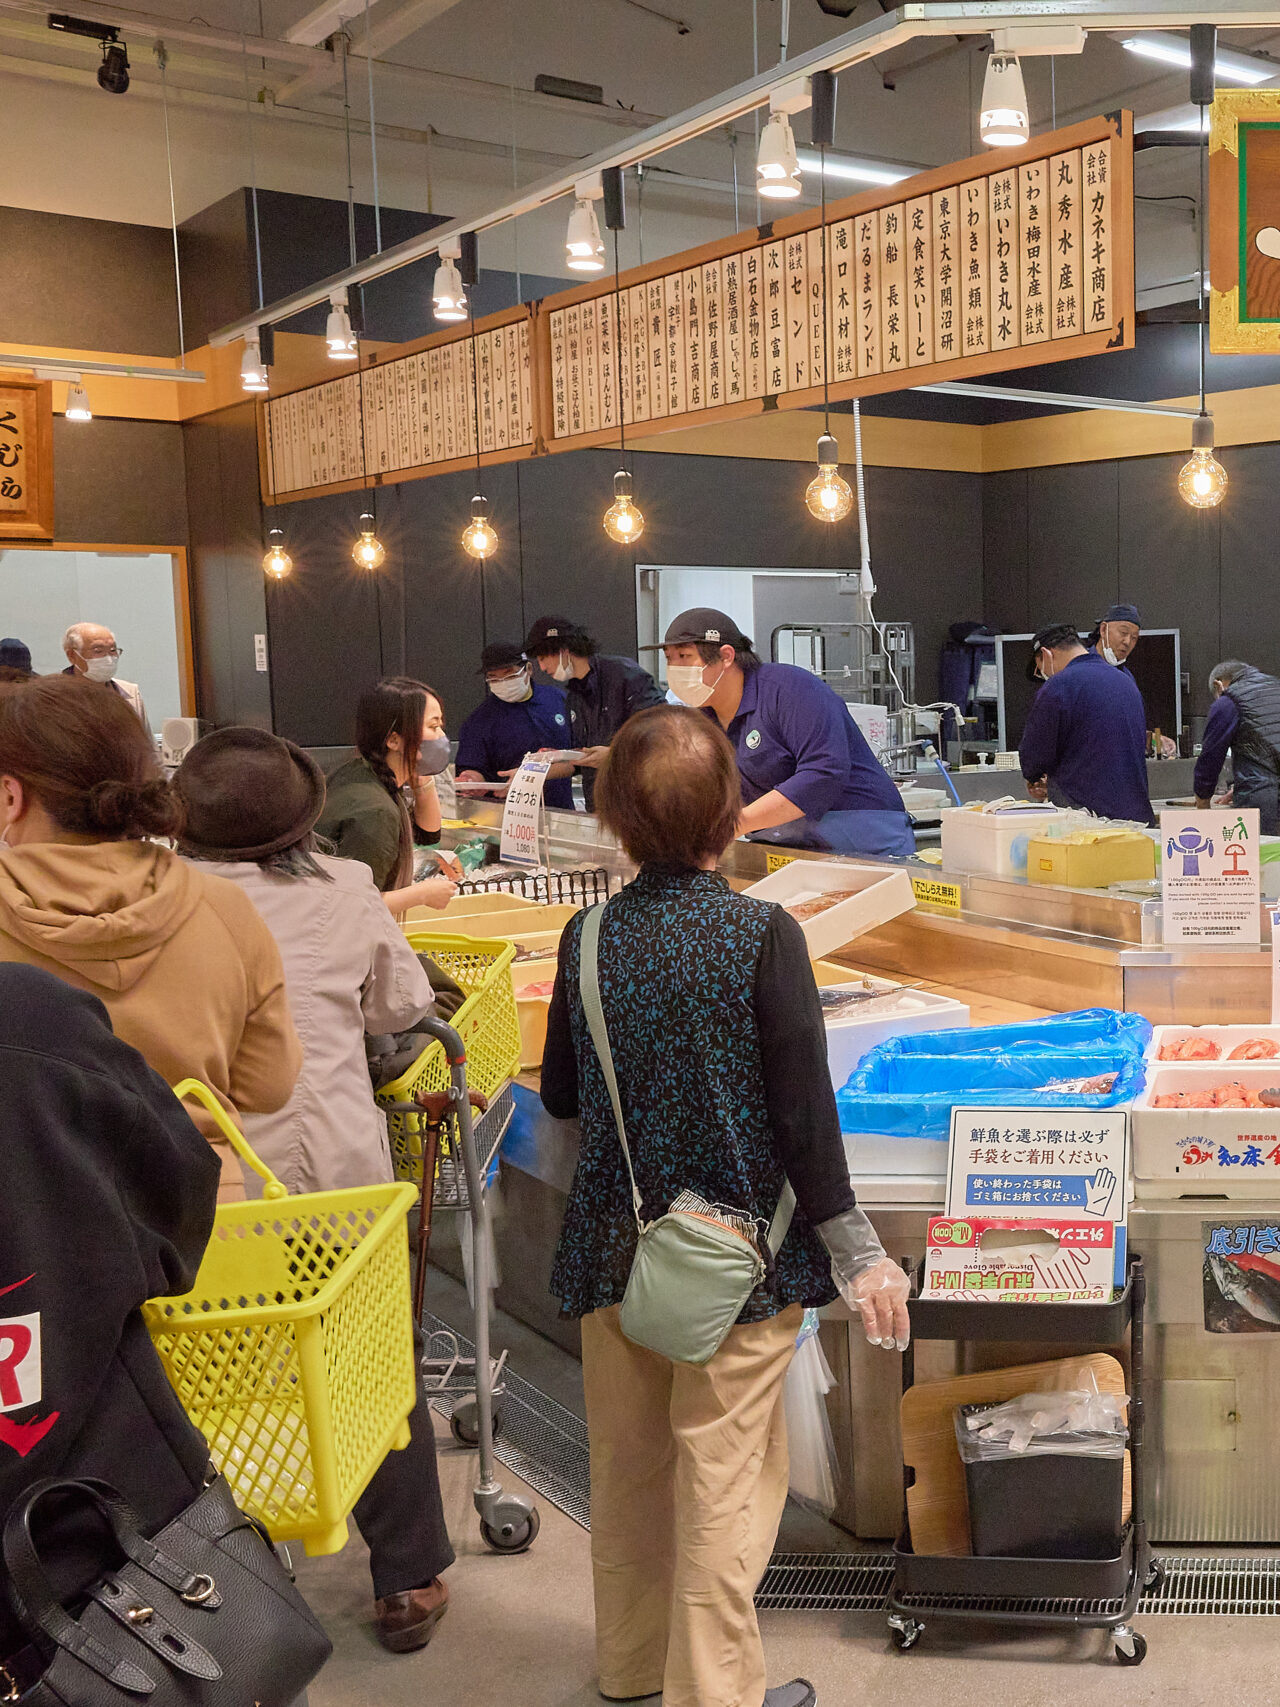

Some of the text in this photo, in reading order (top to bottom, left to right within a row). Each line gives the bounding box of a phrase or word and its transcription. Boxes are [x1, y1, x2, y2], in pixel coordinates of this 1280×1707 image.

[836, 228, 850, 340] 滝口木材
[939, 196, 954, 351] 東京大学開沼研
[966, 187, 982, 310] いわき魚類
[997, 218, 1013, 341] いわき丸水
[1025, 169, 1042, 298] いわき梅田水産
[1057, 160, 1073, 291] 丸秀水産
[1090, 191, 1107, 323] カネキ商店
[688, 274, 700, 405] 小島門吉商店
[708, 299, 719, 400] 佐野屋商店
[747, 255, 760, 359] 白石金物店
[768, 250, 782, 388] 次郎豆富店
[860, 220, 874, 368] だるまランド
[969, 1128, 1110, 1144] 鮮魚を選ぶ際は必ず
[969, 1149, 1109, 1165] 手袋をご着用ください
[973, 1178, 1062, 1190] 使い終わった手袋は
[973, 1191, 1081, 1202] ゴミ箱にお捨てください
[1217, 1145, 1265, 1167] 知床
